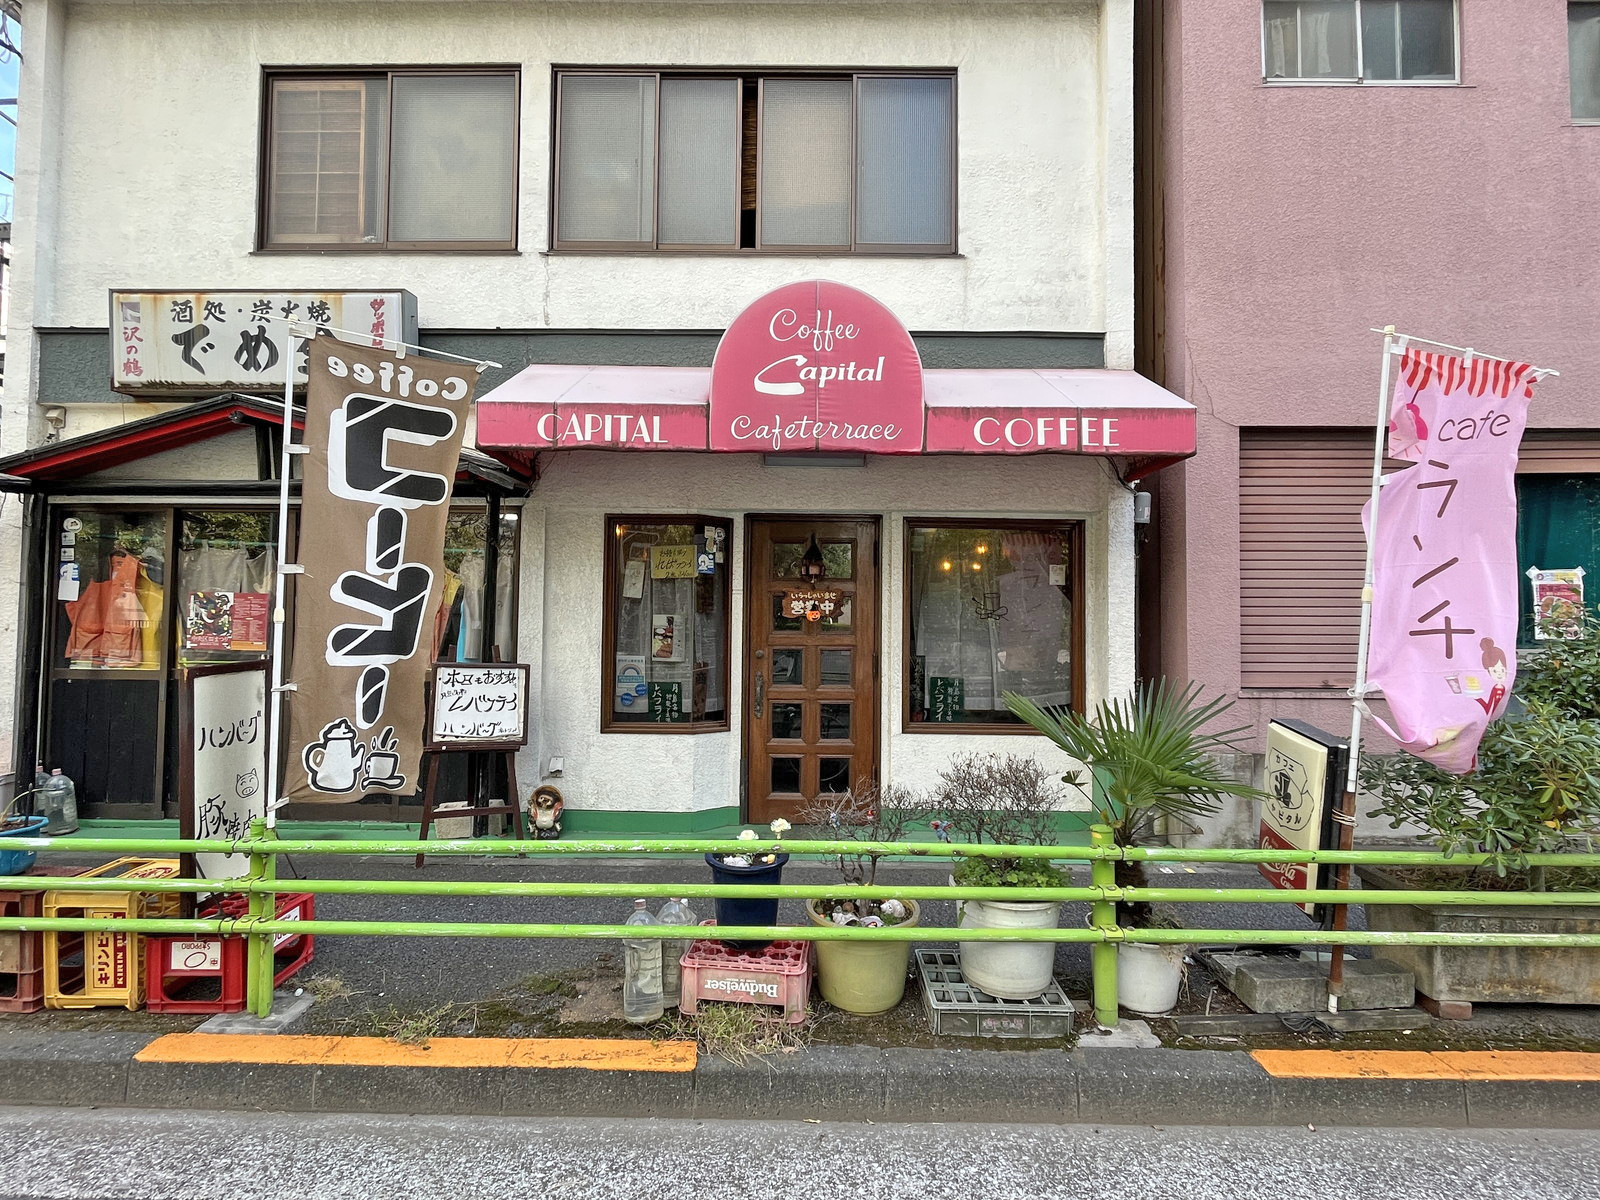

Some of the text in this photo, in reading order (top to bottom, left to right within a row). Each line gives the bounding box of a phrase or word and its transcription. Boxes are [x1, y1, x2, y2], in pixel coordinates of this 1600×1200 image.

[171, 299, 332, 323] 酒処・炭火焼
[768, 308, 860, 352] Coffee
[122, 326, 144, 377] 沢の鶴
[753, 354, 884, 396] Capital
[537, 412, 669, 444] CAPITAL
[730, 414, 902, 451] Cafeterrace
[973, 415, 1120, 447] COFFEE
[1437, 409, 1511, 443] cafe
[1408, 459, 1476, 660] ランチ
[1275, 753, 1295, 773] カフェ
[116, 951, 124, 985] KIRIN
[704, 979, 778, 997] Budweiser
